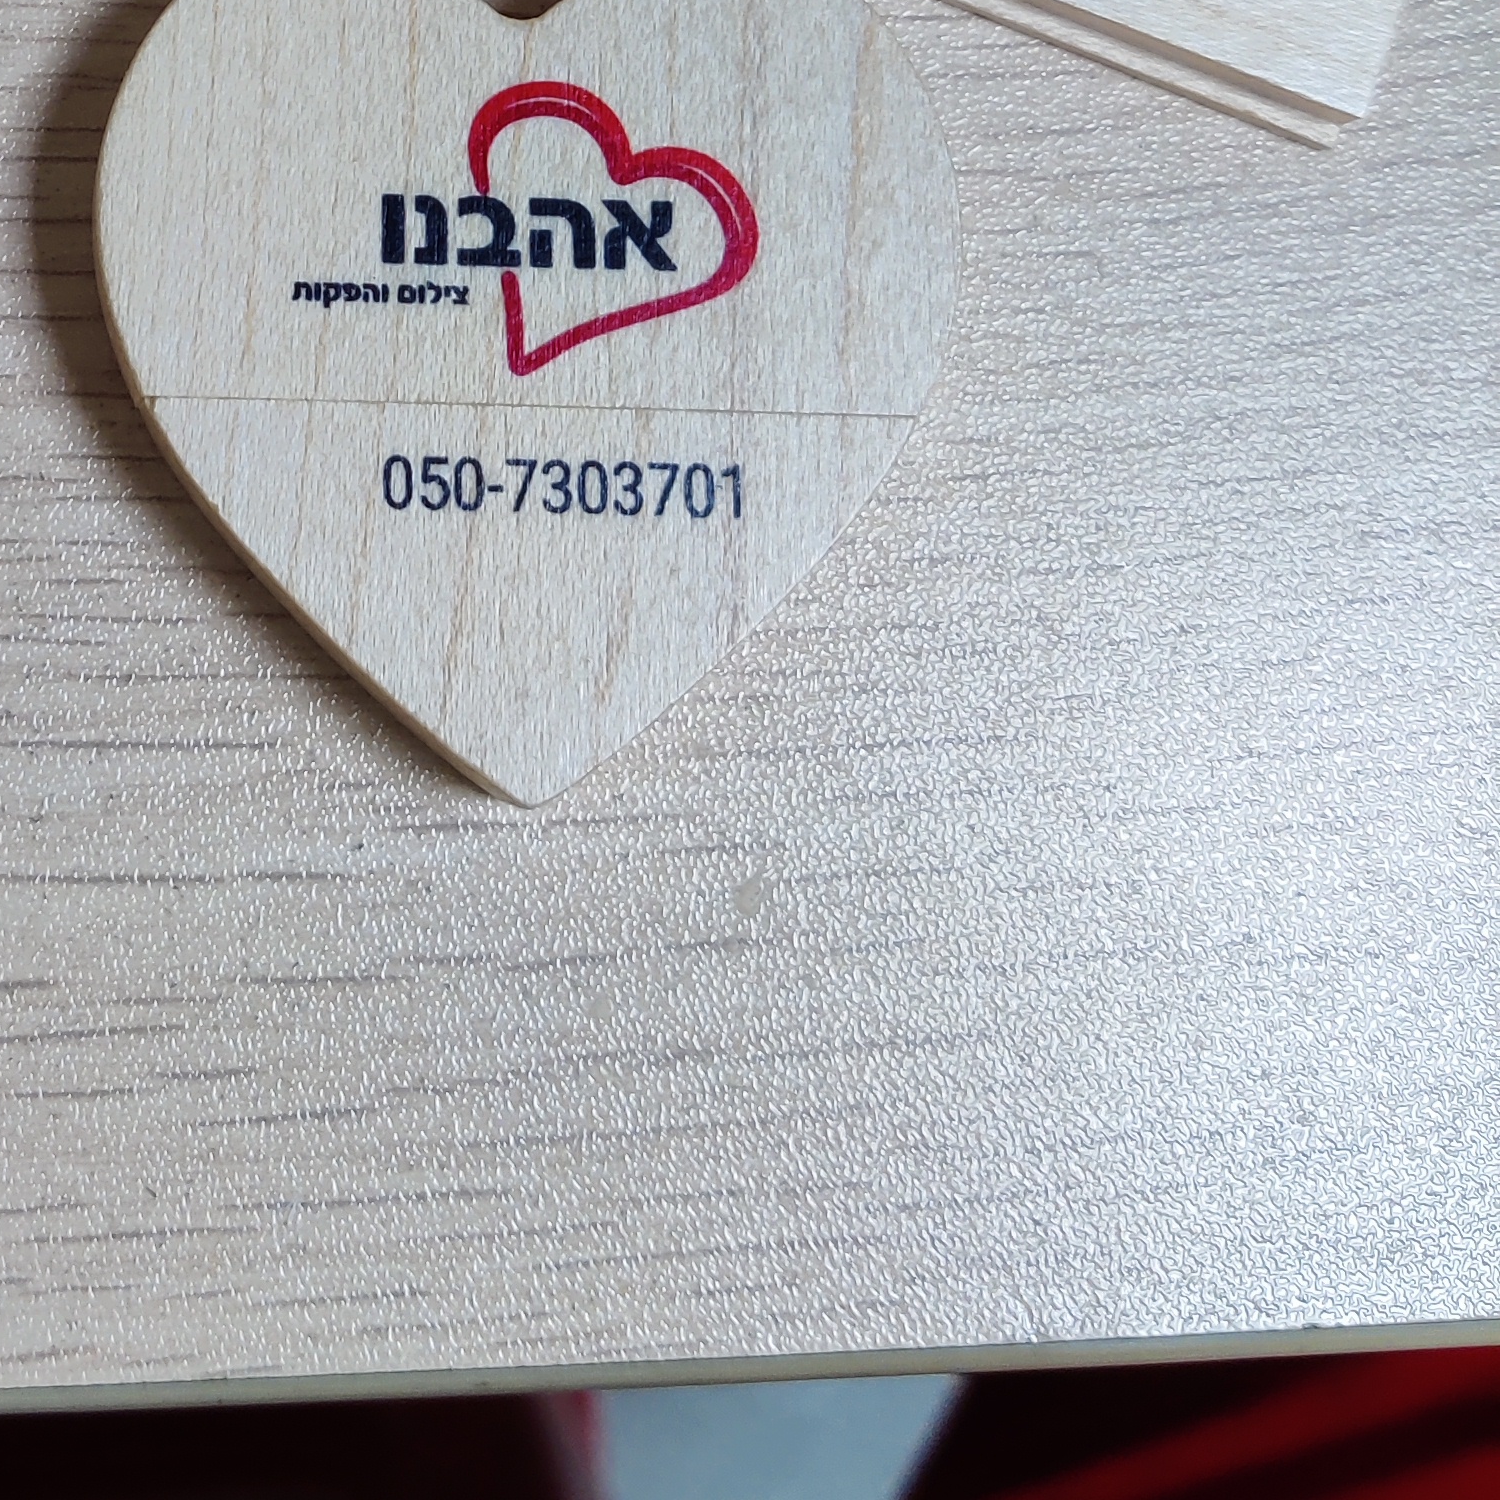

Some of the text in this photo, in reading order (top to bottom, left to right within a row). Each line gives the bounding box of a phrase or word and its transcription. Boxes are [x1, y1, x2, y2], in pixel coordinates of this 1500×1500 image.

[381, 193, 677, 271] אהבנו
[292, 280, 470, 308] צילום והפקות
[382, 454, 744, 518] 050-7303701
